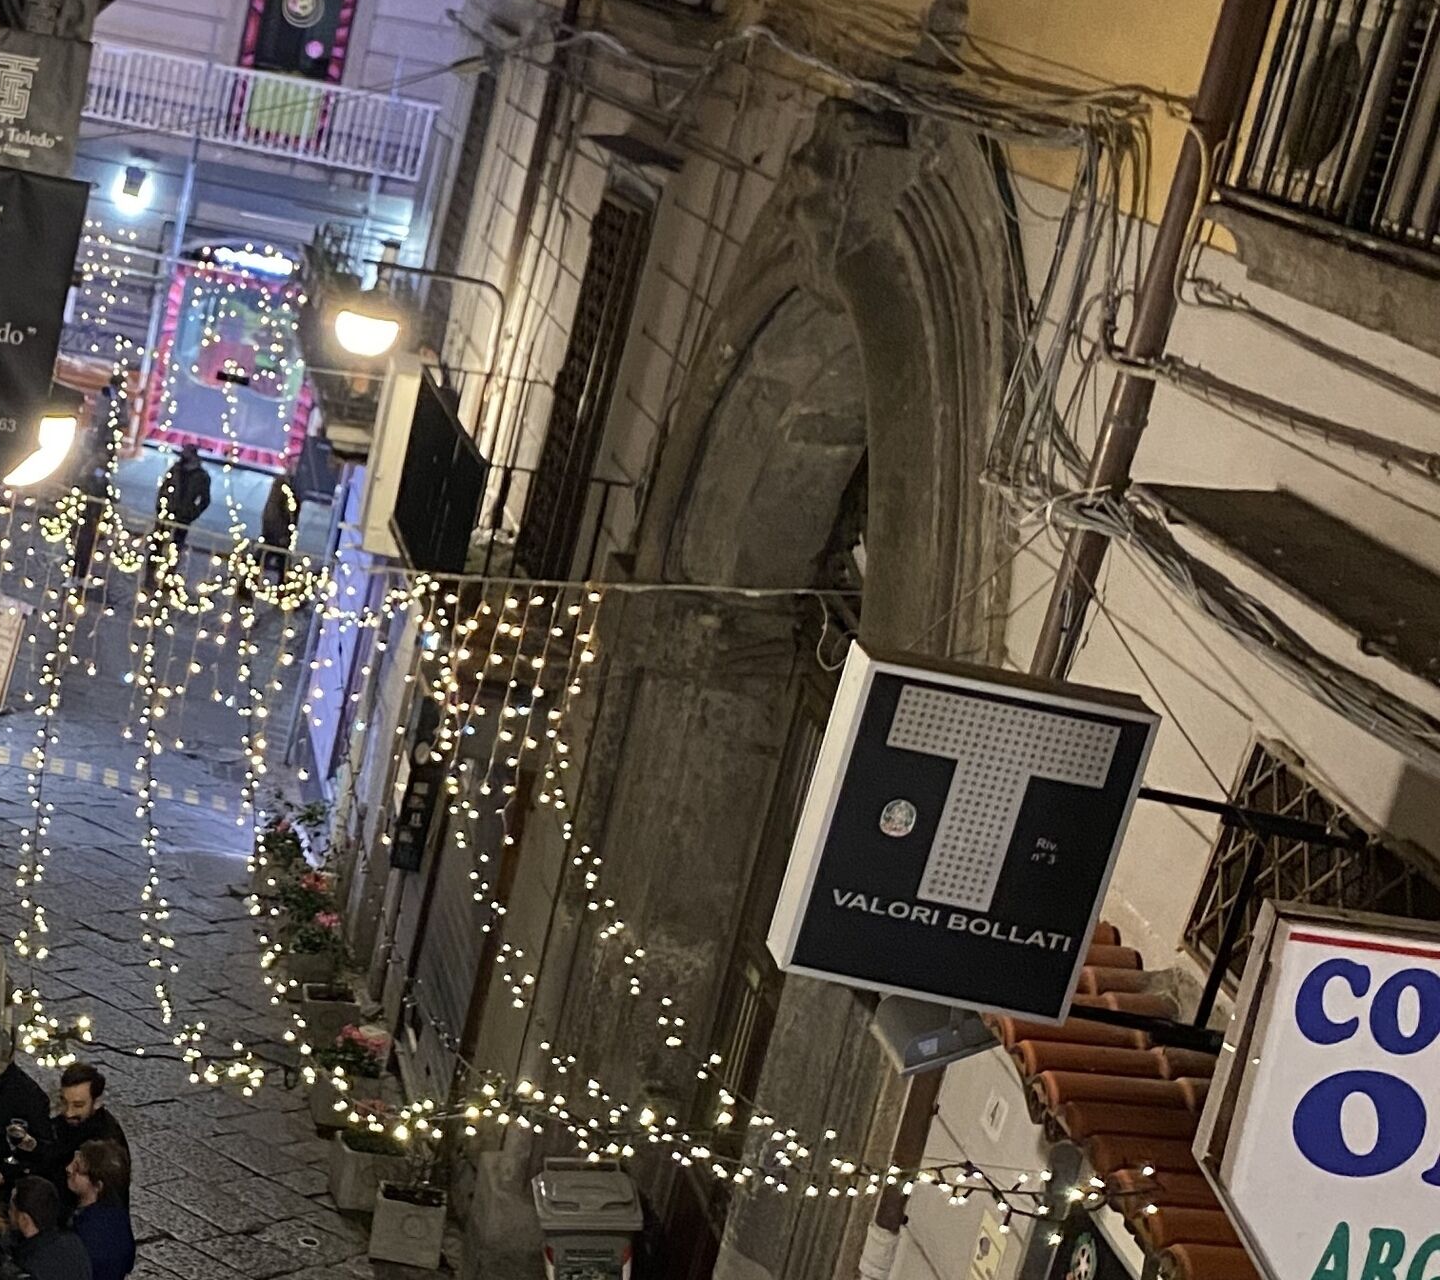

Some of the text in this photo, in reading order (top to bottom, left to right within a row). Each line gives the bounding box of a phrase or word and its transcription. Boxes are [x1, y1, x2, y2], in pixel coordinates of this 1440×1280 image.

[832, 888, 1072, 952] VALORI BOLLATI
[1292, 1069, 1440, 1187] O
